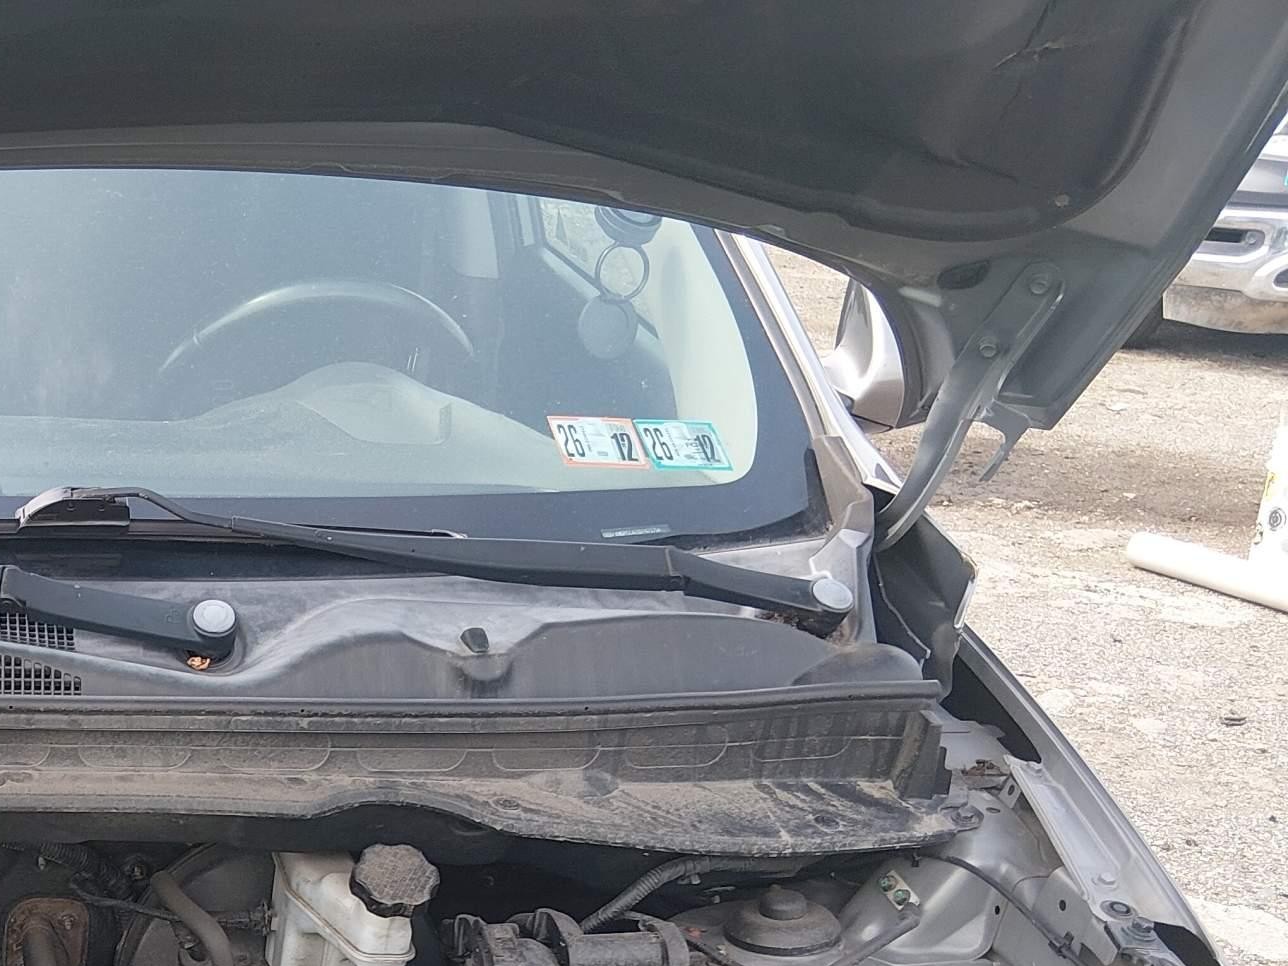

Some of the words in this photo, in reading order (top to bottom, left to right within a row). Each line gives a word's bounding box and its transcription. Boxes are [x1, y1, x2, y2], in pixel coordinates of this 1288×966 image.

[557, 424, 585, 458] 26
[610, 432, 639, 462] 12
[643, 427, 674, 461] 26
[694, 433, 722, 463] 12
